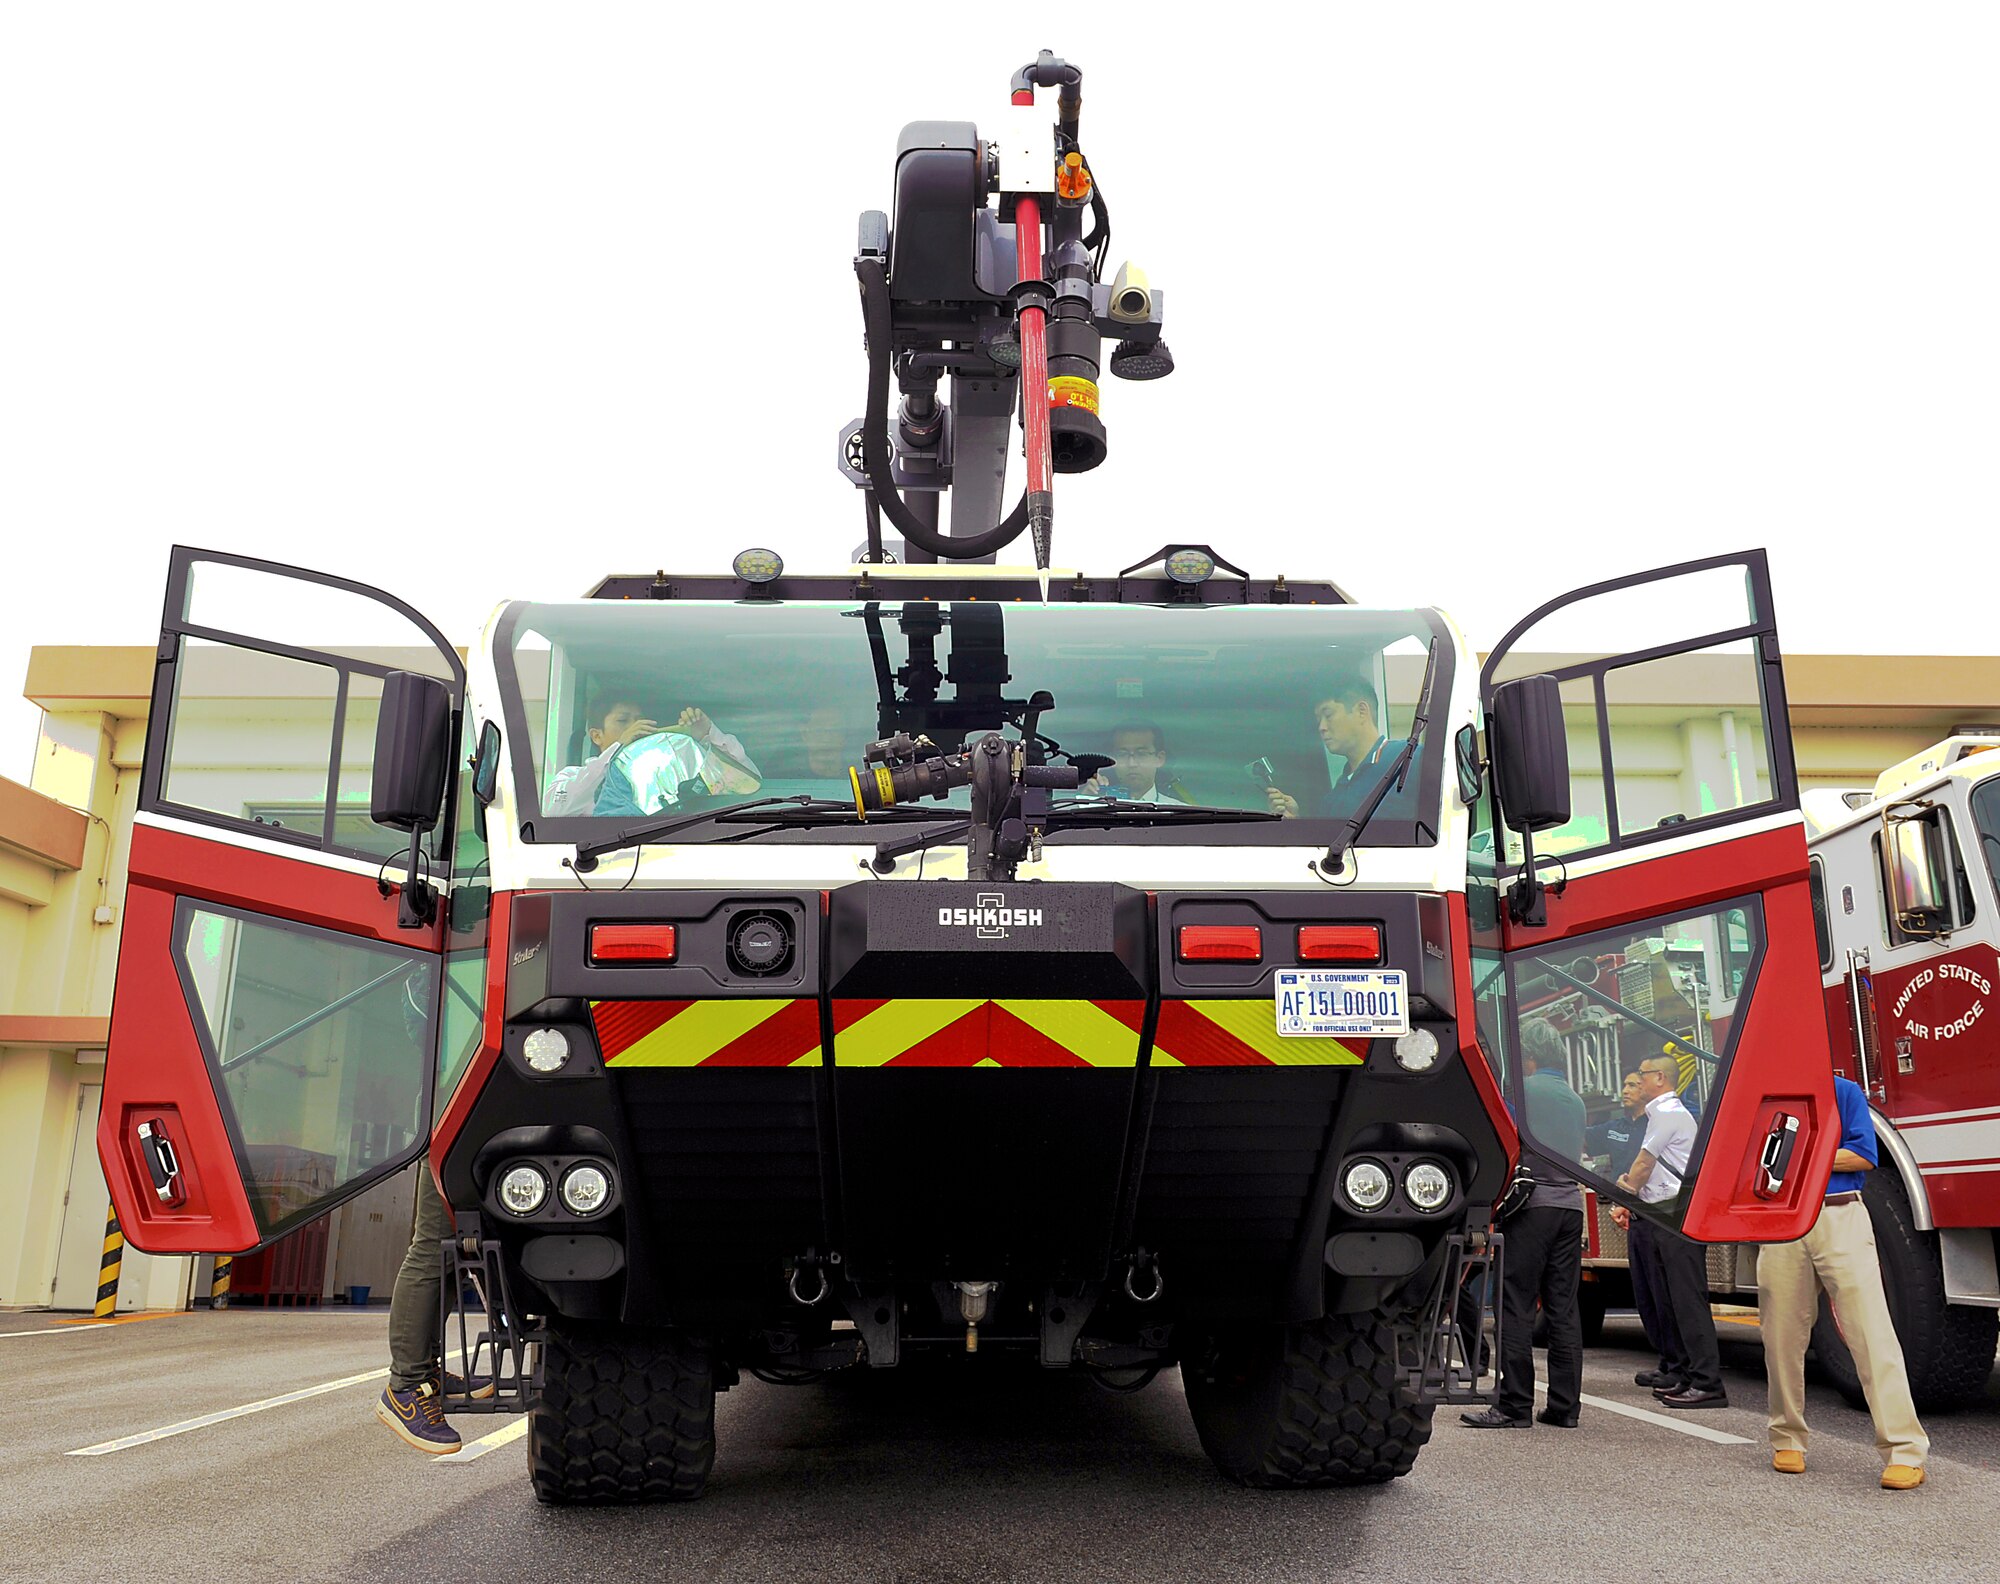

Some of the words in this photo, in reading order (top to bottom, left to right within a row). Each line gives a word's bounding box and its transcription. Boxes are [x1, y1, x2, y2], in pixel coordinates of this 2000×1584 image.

[938, 908, 1043, 926] OSHKOSH
[1311, 974, 1324, 982] U.S.
[1325, 974, 1369, 982] GOVERNMENT
[1282, 991, 1399, 1016] AF15L00001
[1892, 968, 1934, 1018] UNITED
[1938, 964, 1992, 996] STATES
[1905, 1019, 1929, 1040] AIR
[1934, 999, 1985, 1041] FORCE
